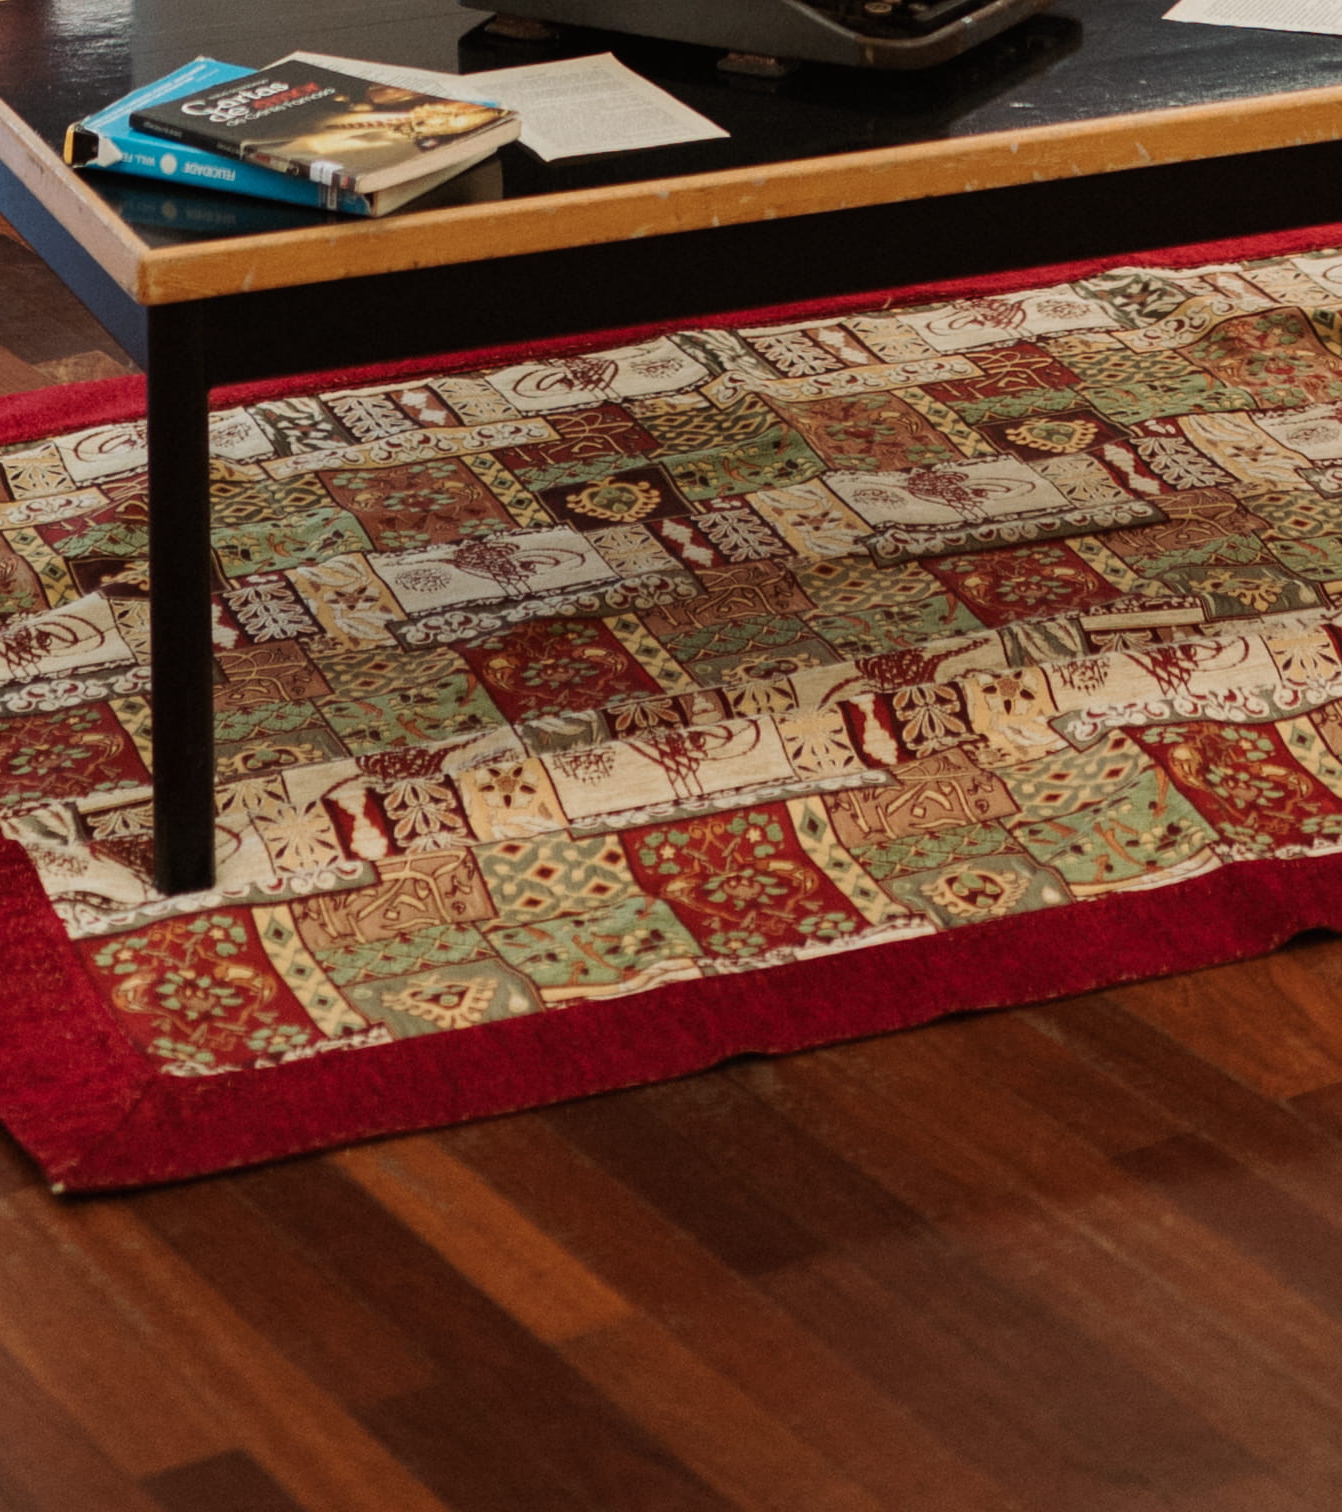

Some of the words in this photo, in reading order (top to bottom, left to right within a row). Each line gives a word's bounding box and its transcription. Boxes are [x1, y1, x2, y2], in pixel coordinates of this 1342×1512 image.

[181, 80, 289, 116] Cartas
[135, 153, 156, 167] WILL
[184, 161, 236, 182] FELICIDADE
